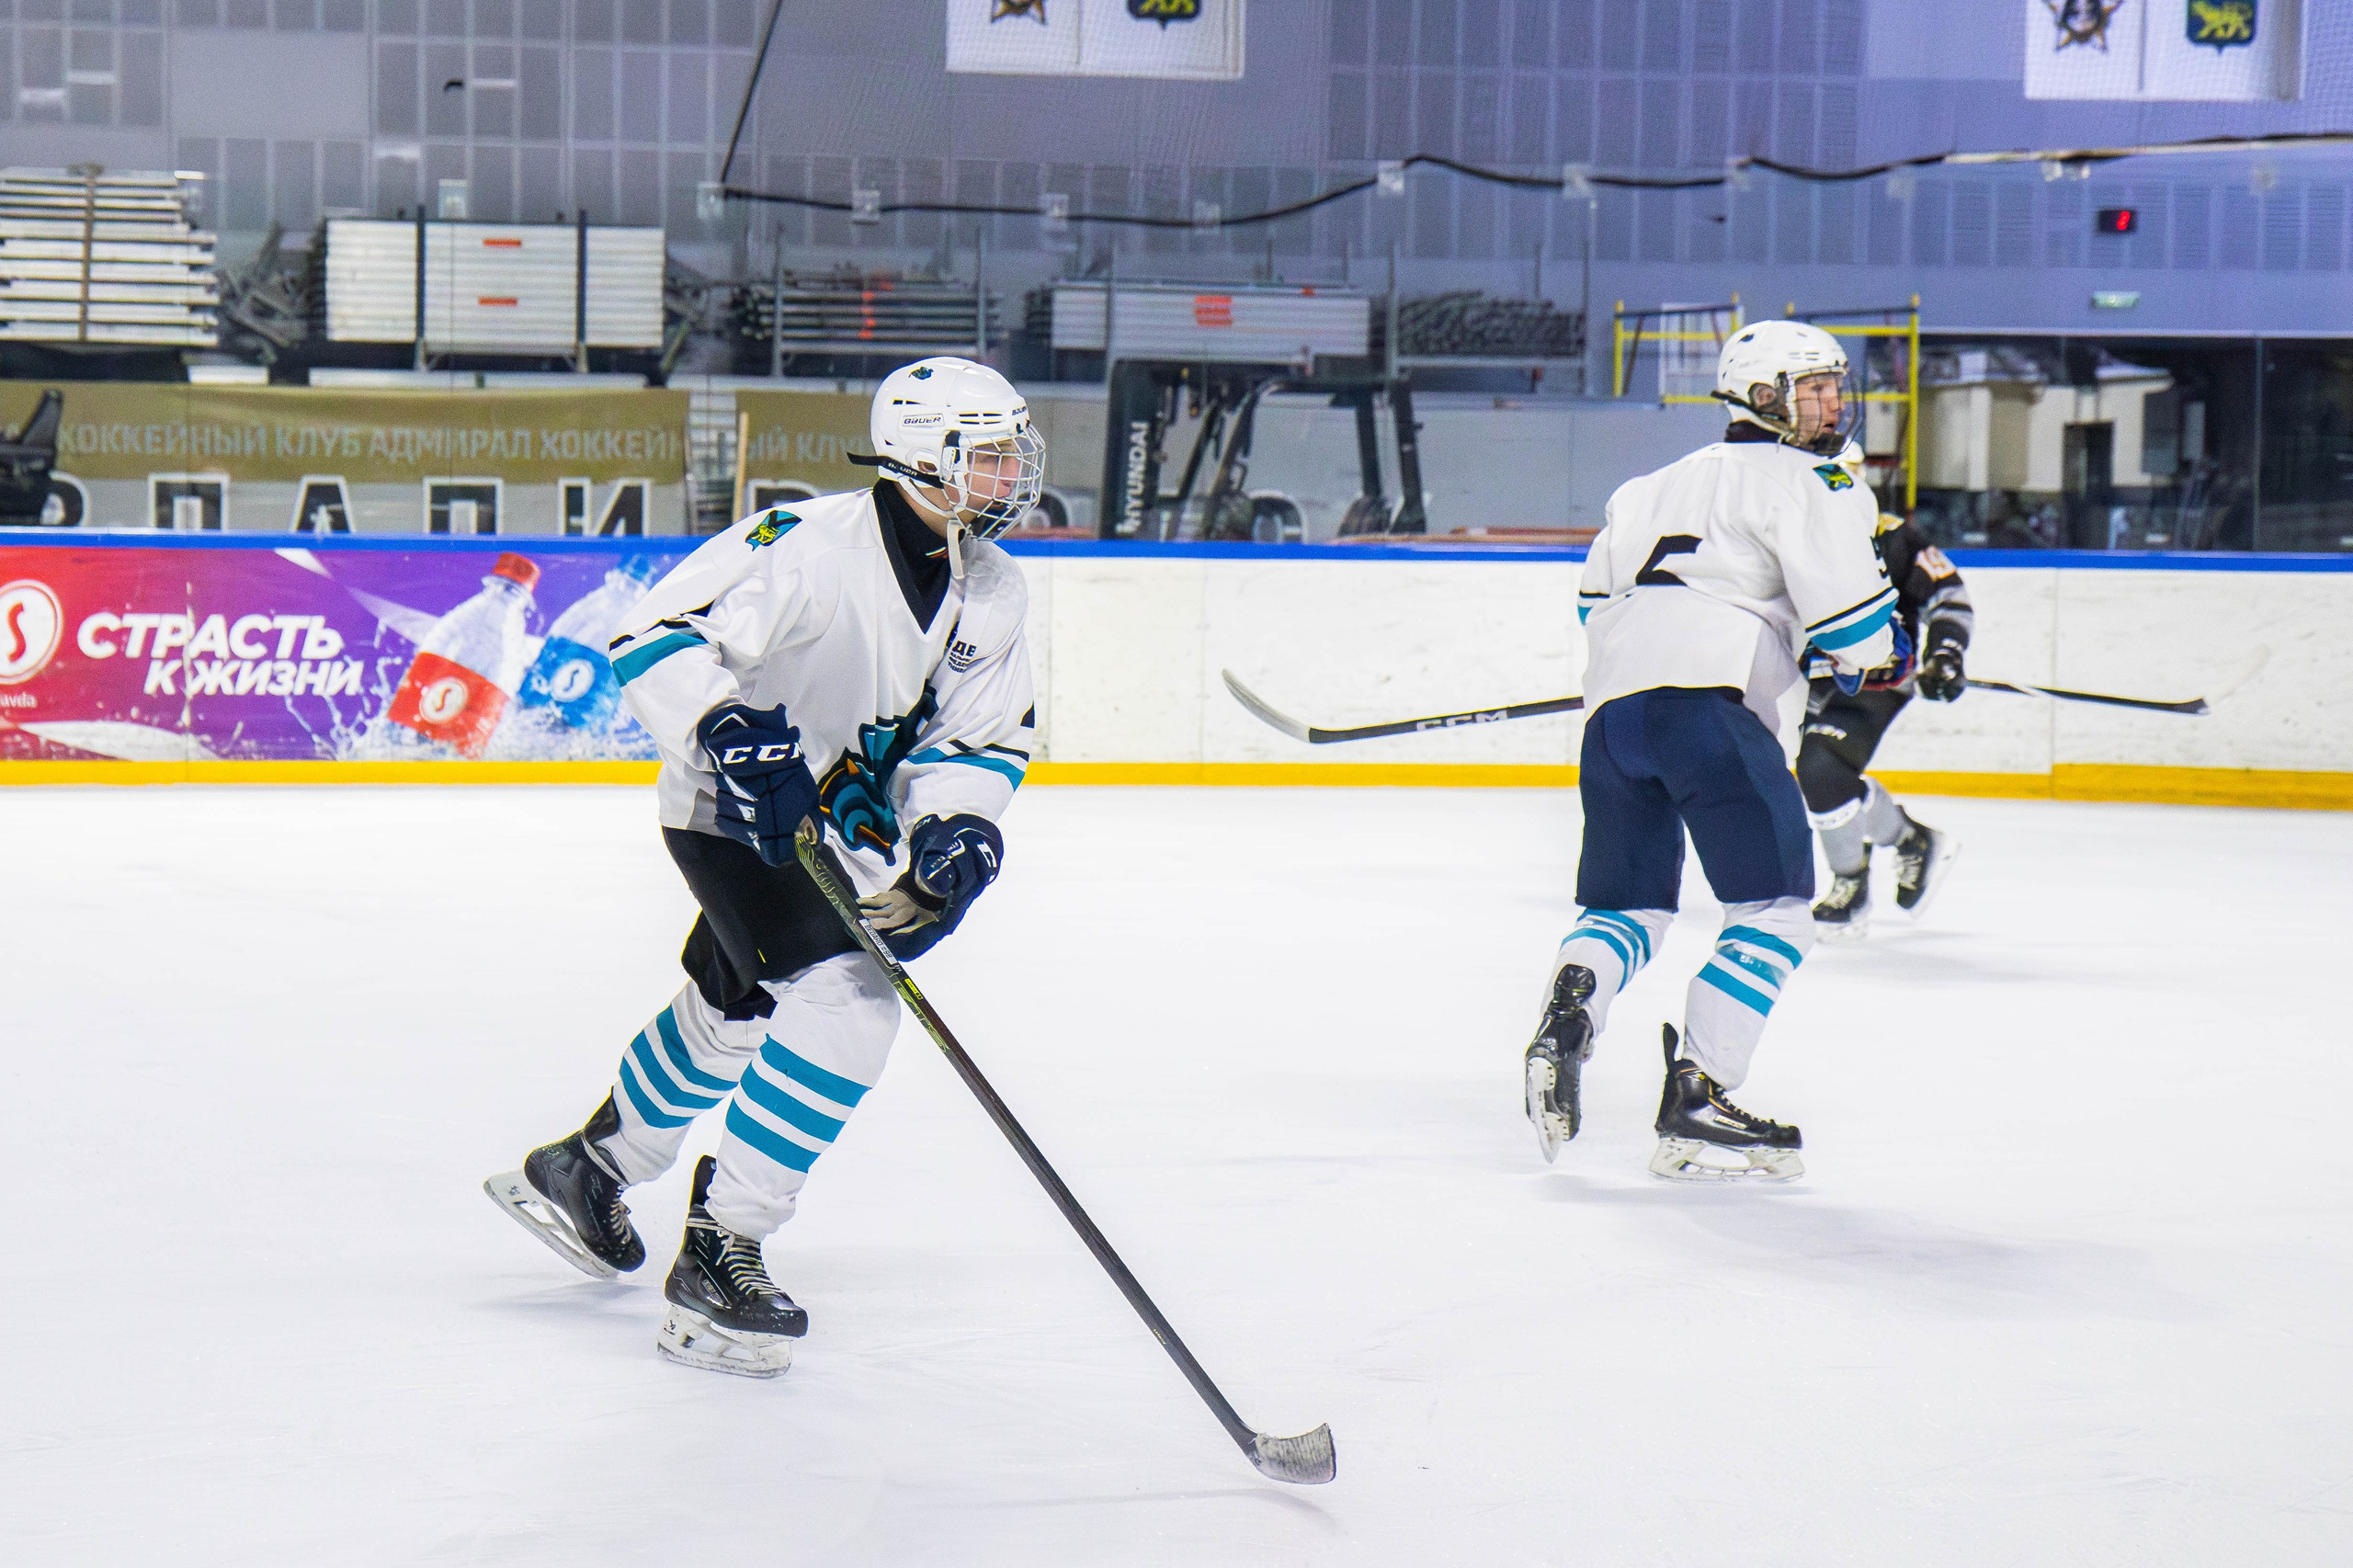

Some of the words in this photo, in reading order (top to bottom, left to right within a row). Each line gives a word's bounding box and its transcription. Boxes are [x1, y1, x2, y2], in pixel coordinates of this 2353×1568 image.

[904, 416, 941, 425] BAUER
[278, 424, 361, 458] КЛУБ
[77, 613, 344, 659] СТРАСТЬ
[143, 659, 185, 696] К
[188, 660, 364, 697] ЖИЗНИ
